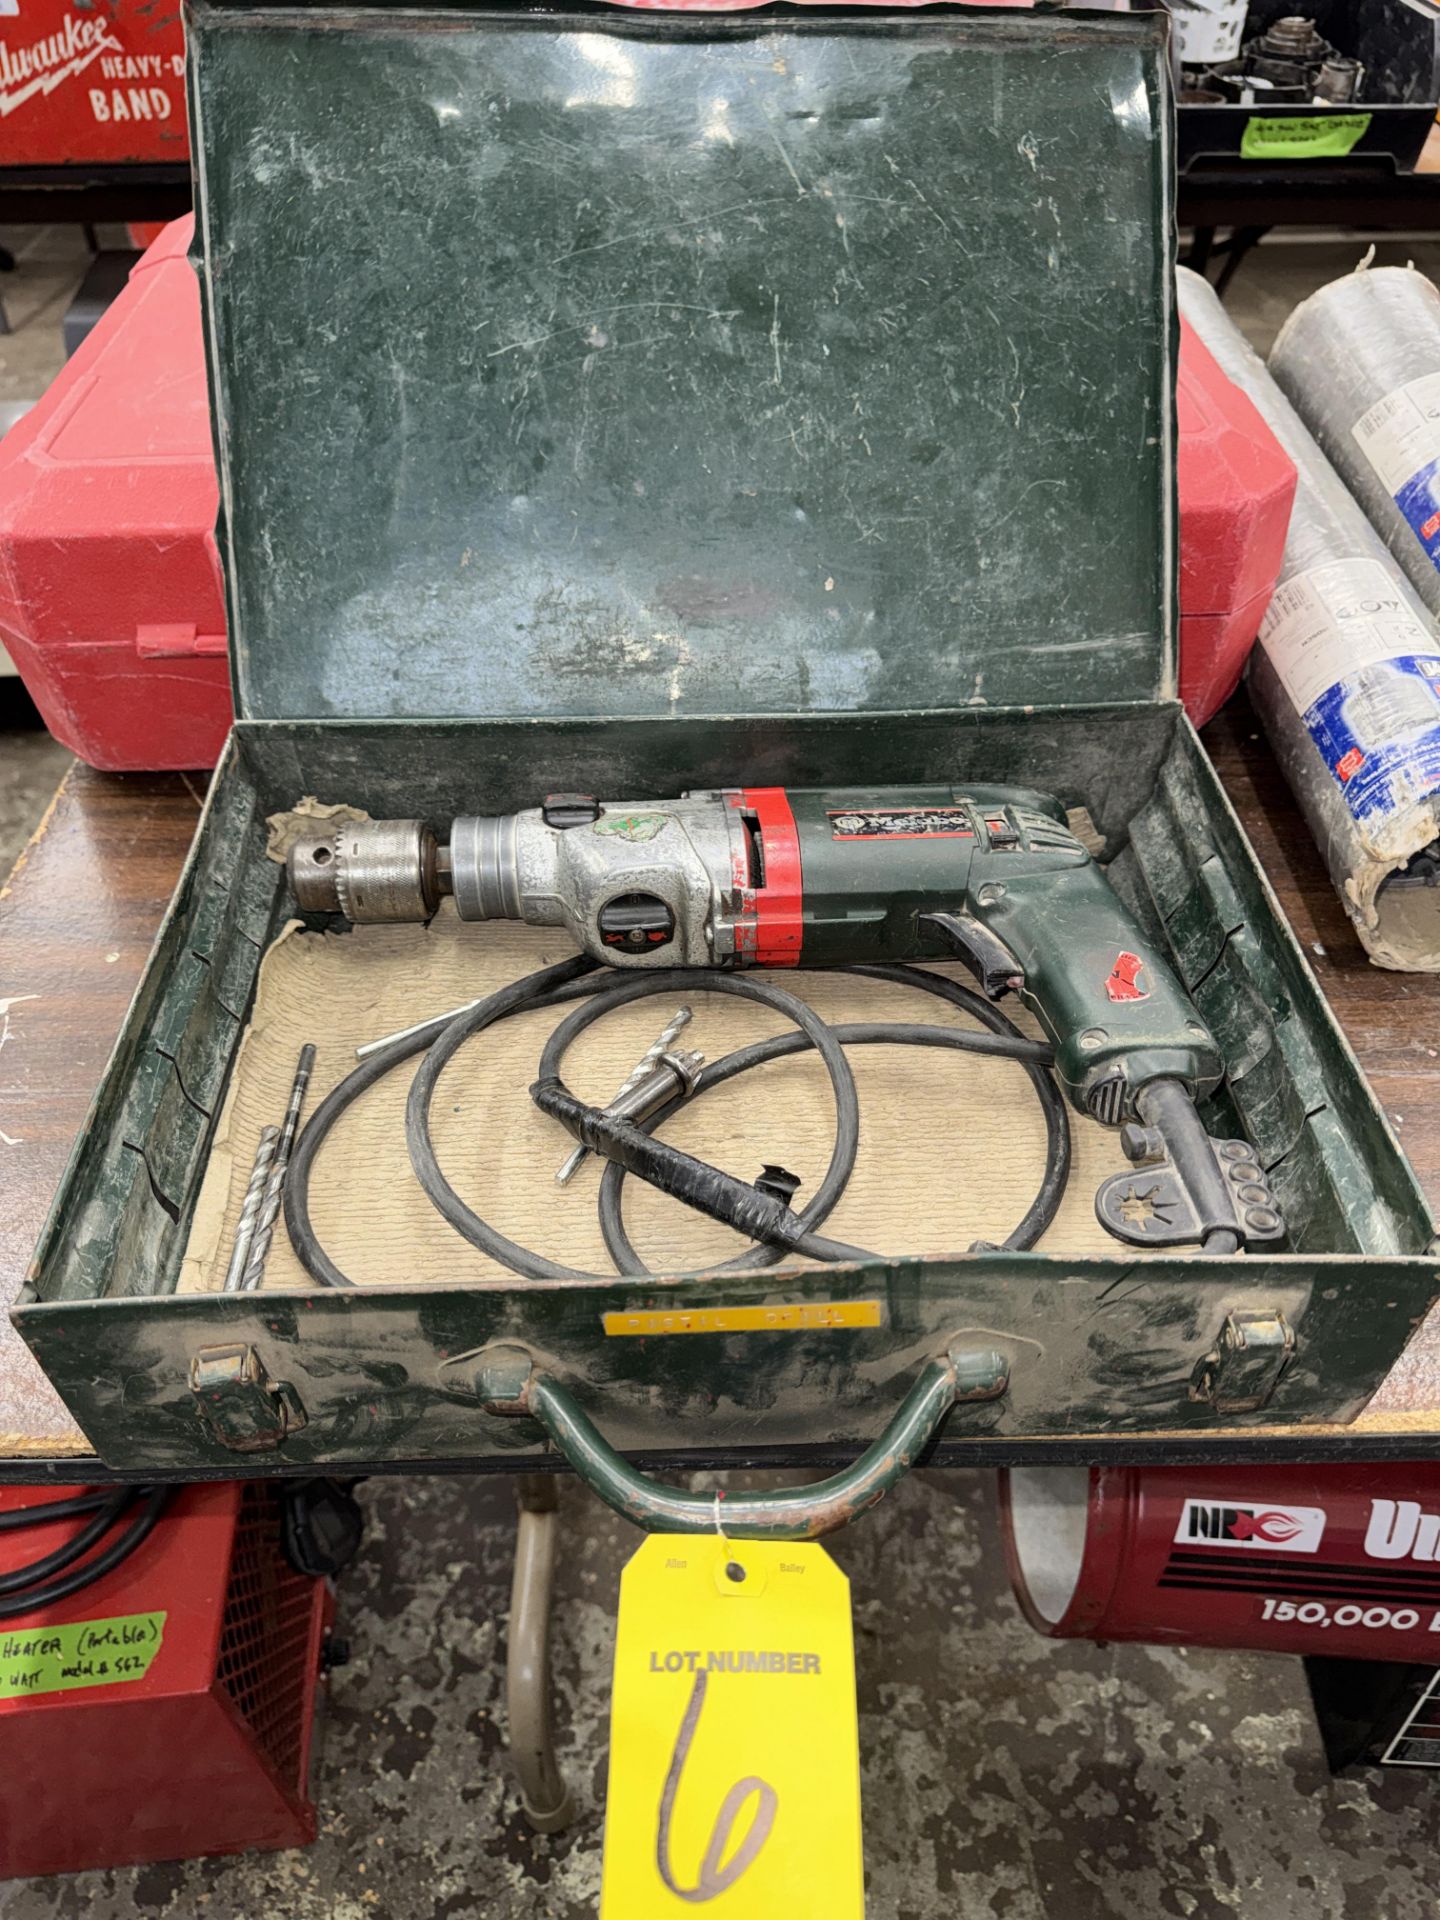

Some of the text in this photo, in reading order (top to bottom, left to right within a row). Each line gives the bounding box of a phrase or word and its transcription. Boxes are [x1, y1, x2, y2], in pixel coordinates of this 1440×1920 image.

[88, 87, 171, 122] BAND
[665, 1558, 806, 1574] Allen Bailey
[1261, 1599, 1420, 1630] 150,000
[649, 1650, 822, 1675] LOT NUMBER
[10, 1669, 44, 1689] WATT
[656, 1668, 778, 1903] 6
